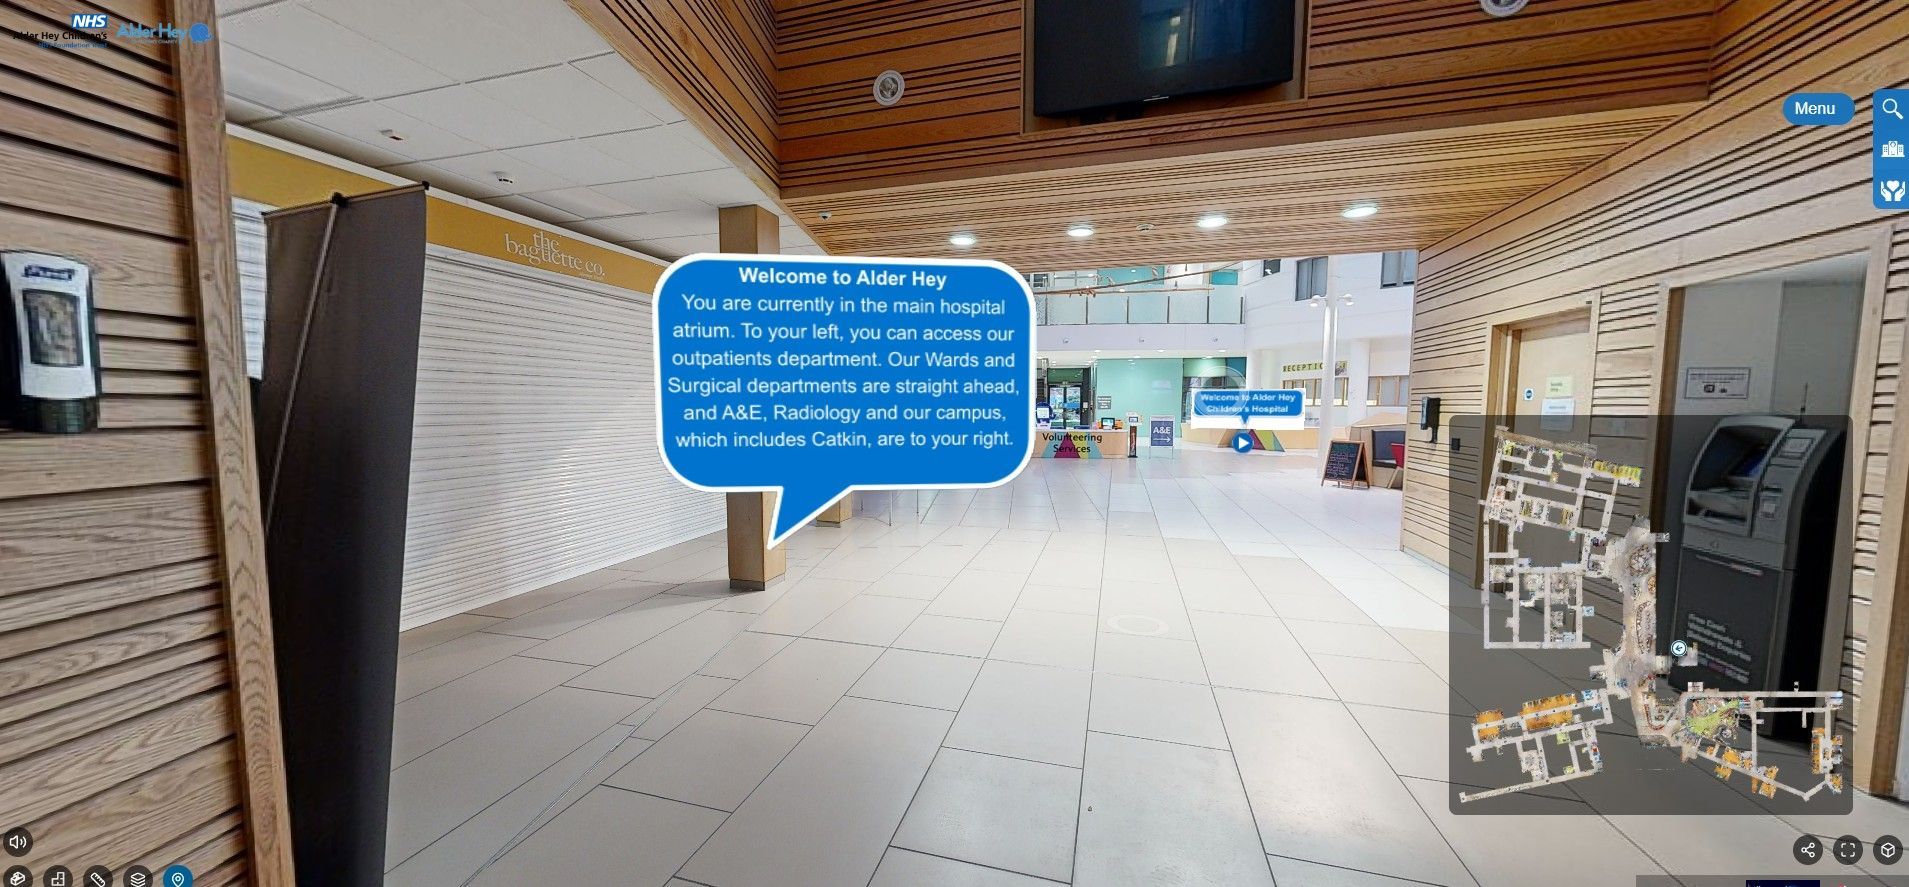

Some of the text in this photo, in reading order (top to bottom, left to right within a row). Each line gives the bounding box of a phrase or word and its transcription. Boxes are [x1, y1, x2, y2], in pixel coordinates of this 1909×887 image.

[533, 231, 560, 252] the
[505, 233, 606, 276] baguette co.
[1283, 362, 1323, 372] RECEPTIO
[1042, 432, 1103, 443] Volunteering
[1053, 444, 1091, 453] Services
